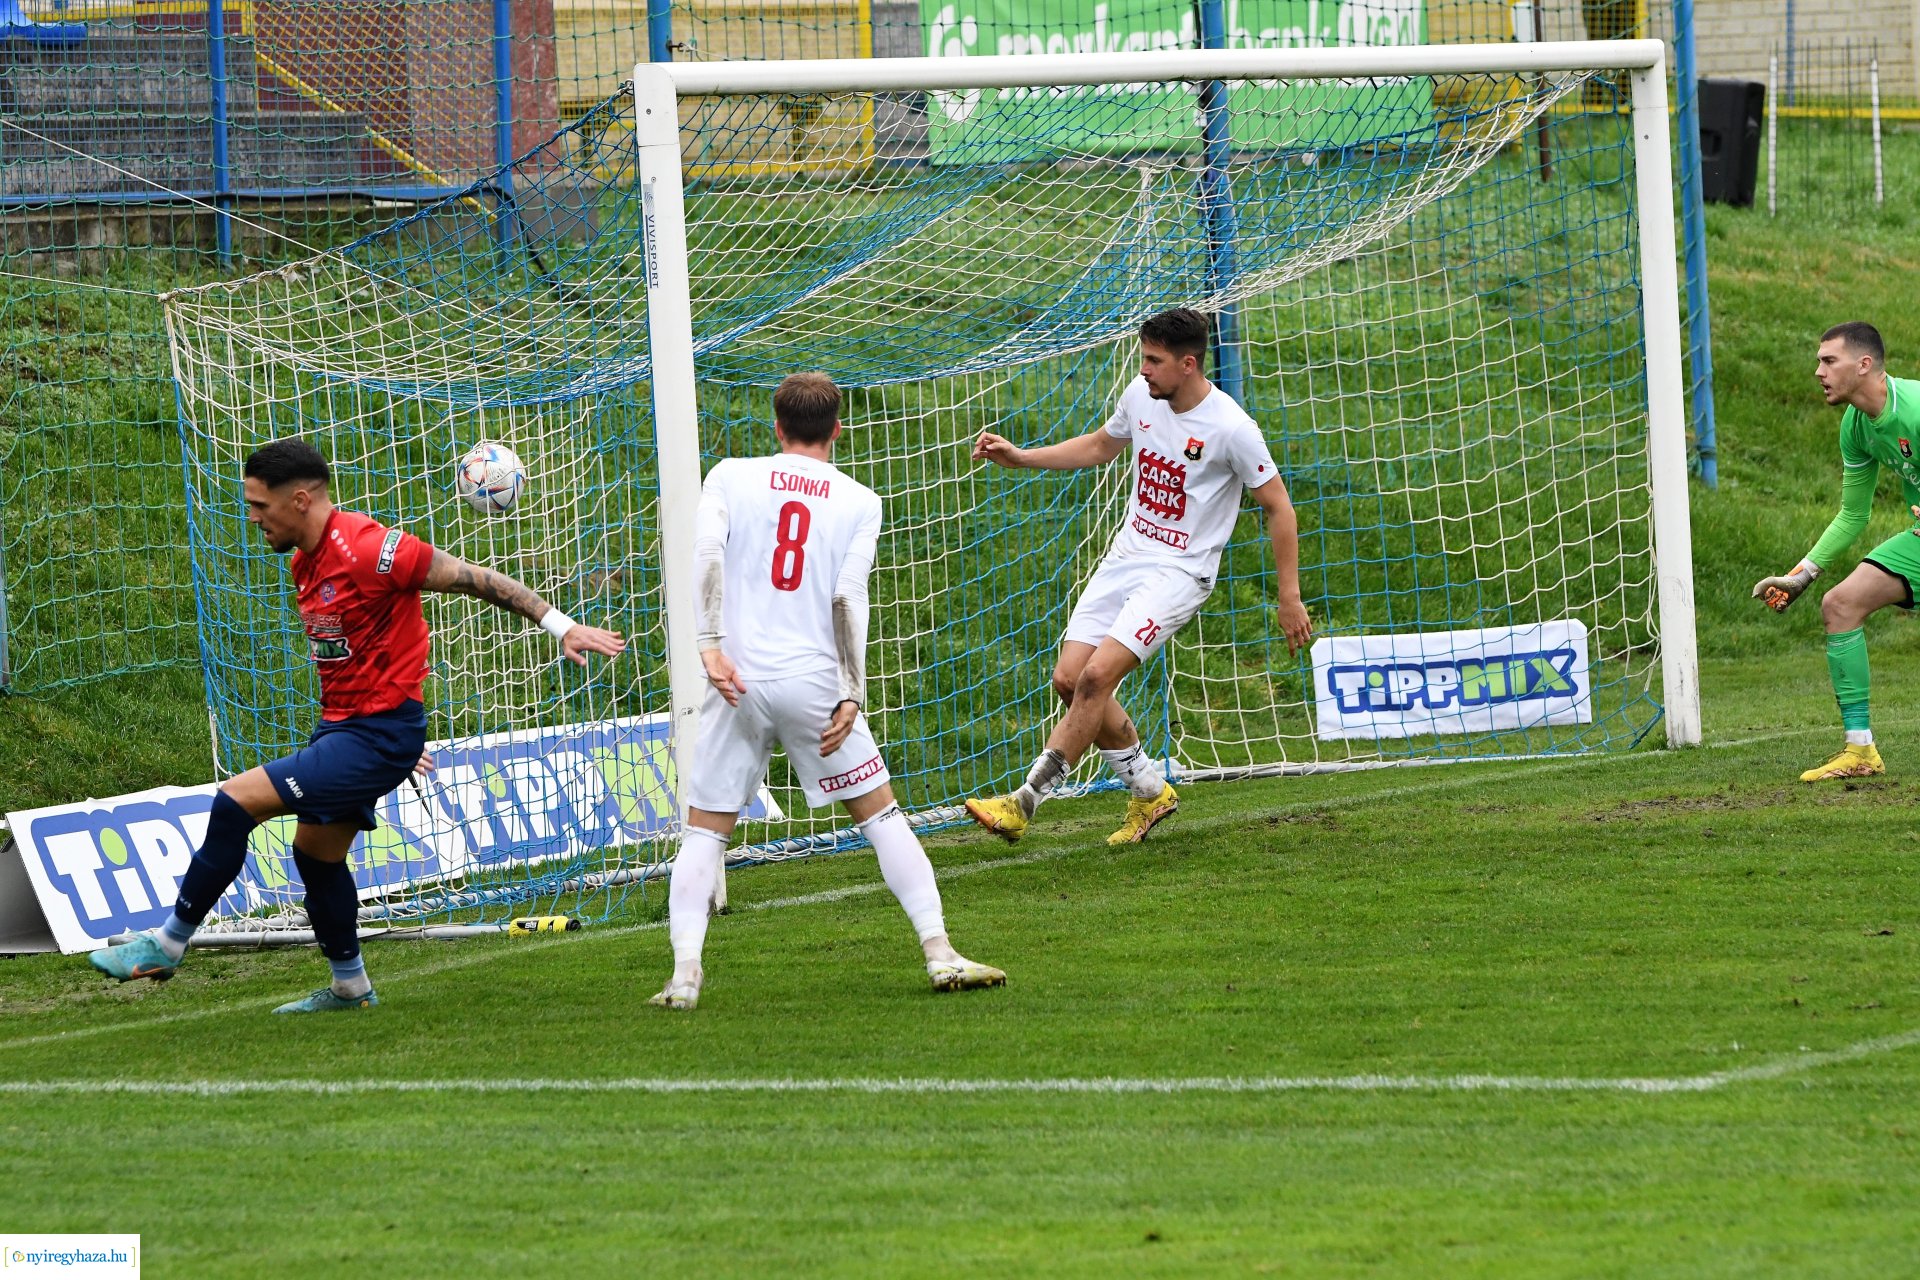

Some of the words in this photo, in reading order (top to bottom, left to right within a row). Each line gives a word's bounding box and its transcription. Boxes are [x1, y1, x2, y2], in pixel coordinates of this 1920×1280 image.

[648, 214, 659, 288] VIVISPORT
[770, 470, 831, 499] CSONKA
[771, 500, 811, 592] 8
[1134, 617, 1161, 647] 26
[285, 776, 304, 799] JAKO
